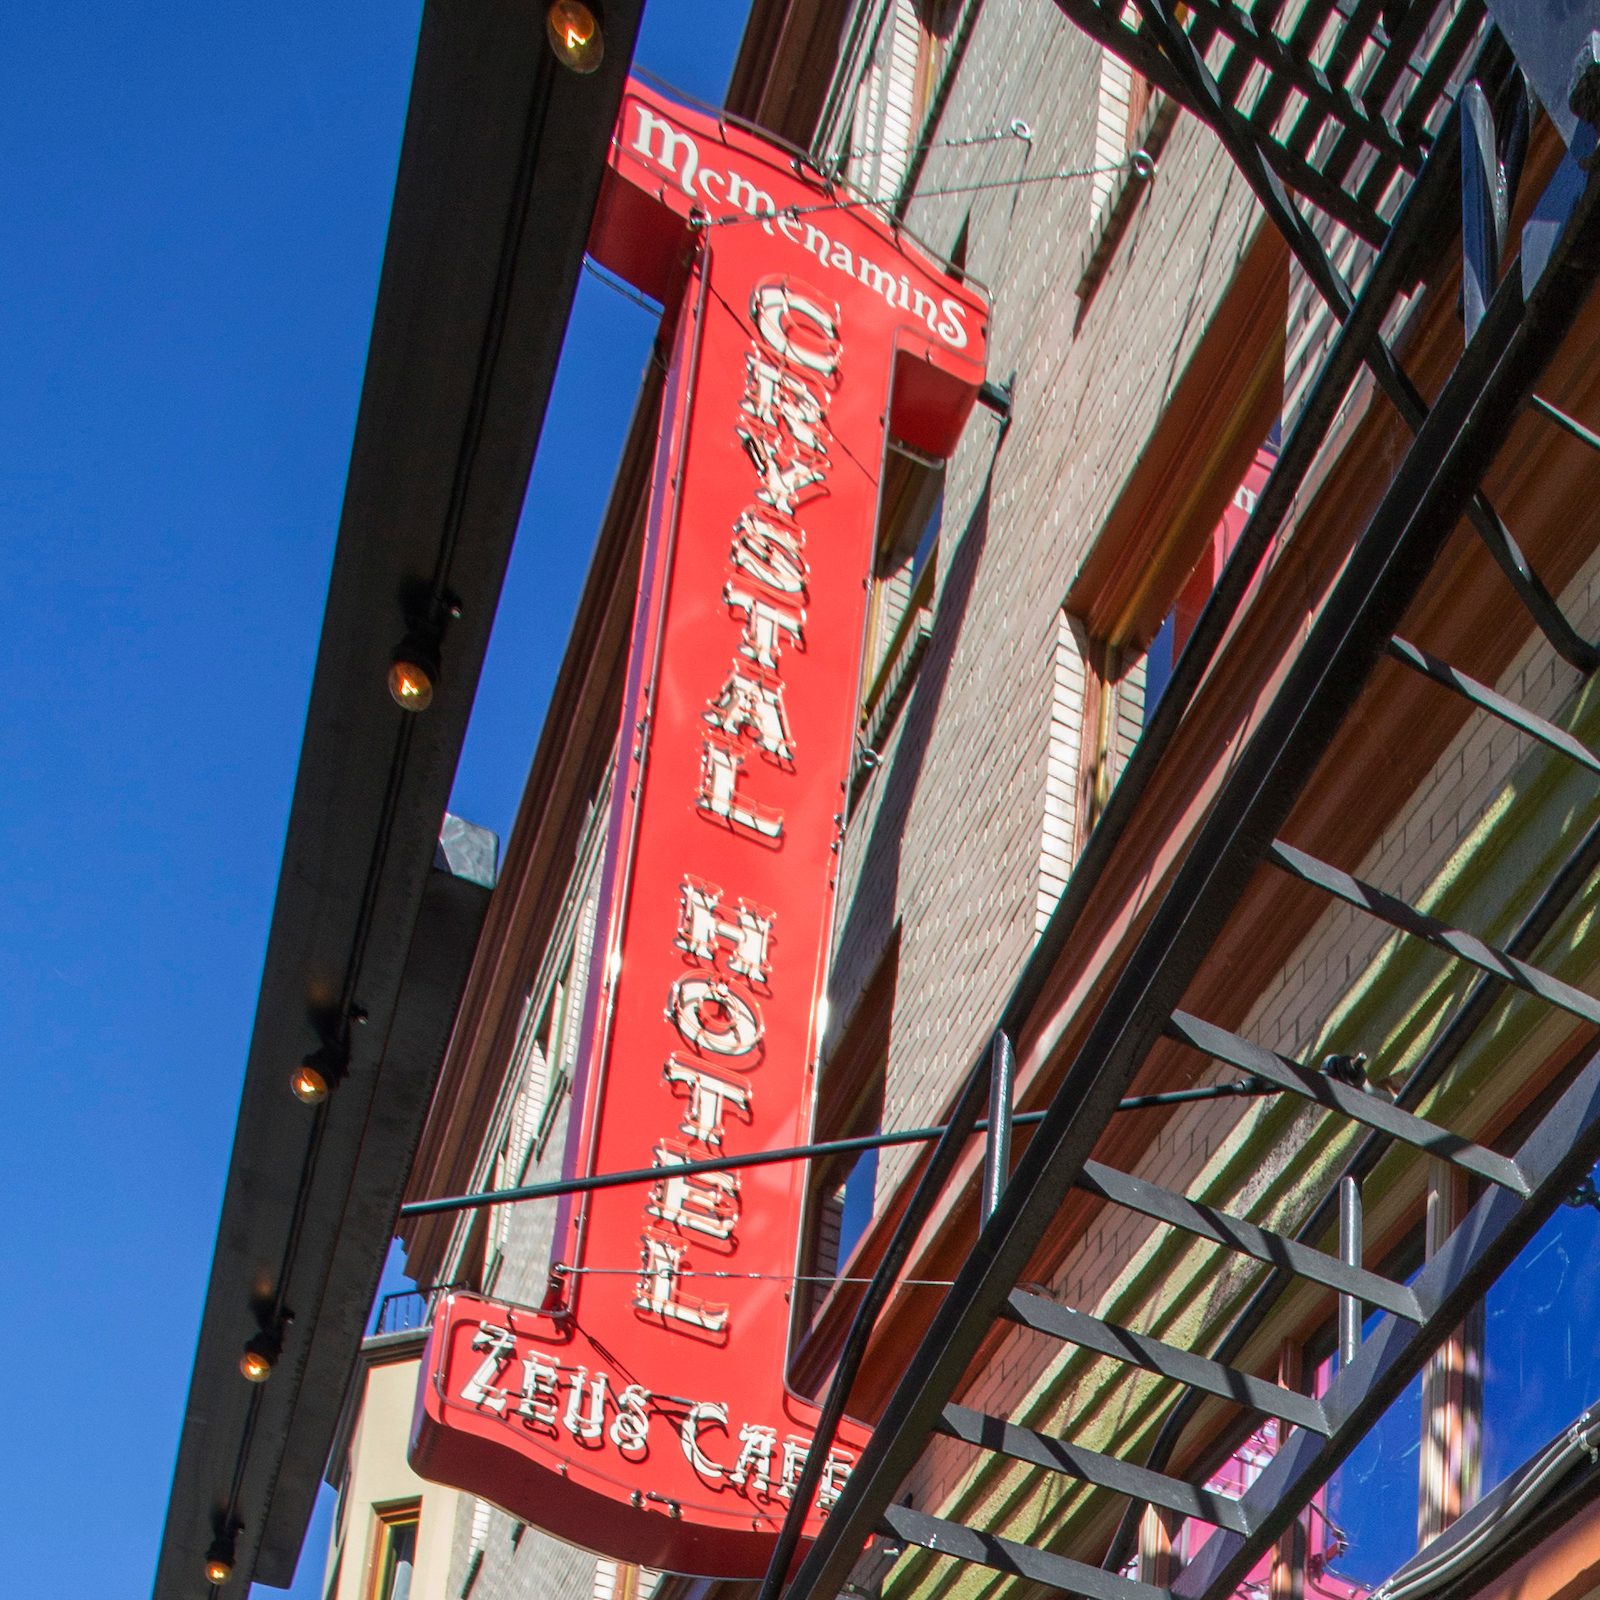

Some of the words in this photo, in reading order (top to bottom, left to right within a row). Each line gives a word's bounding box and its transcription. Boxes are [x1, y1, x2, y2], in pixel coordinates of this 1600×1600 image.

[697, 280, 844, 840] CRYSTAL
[632, 874, 776, 1333] HOTEL
[459, 1319, 650, 1452] ZEUS
